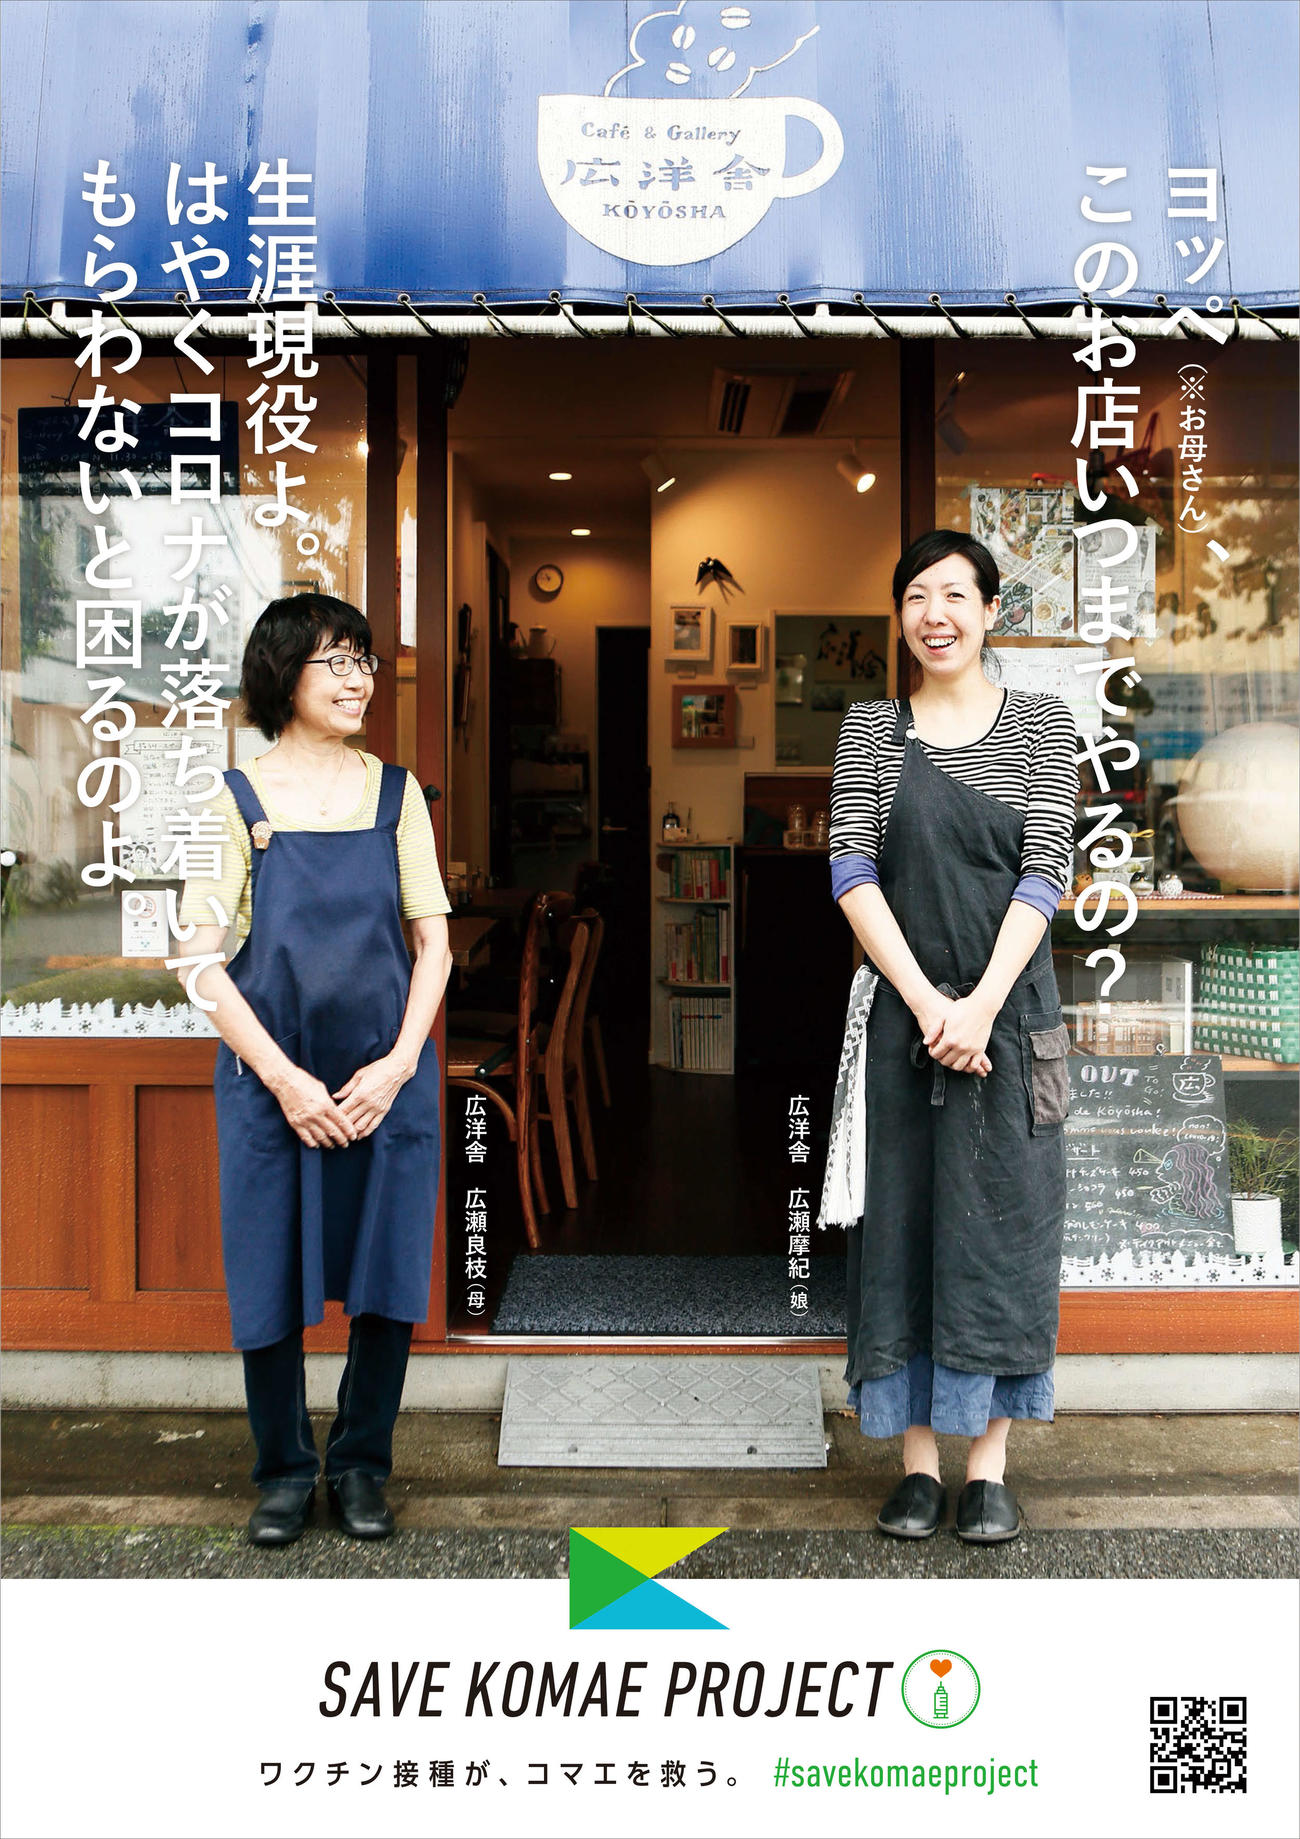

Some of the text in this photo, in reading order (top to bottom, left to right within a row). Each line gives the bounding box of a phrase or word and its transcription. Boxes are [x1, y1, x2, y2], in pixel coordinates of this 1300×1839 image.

[580, 121, 742, 147] Café & Gallery
[559, 153, 772, 192] 広洋舎
[602, 200, 727, 220] KŌYŌSHA
[1080, 1064, 1140, 1087] OUT
[1128, 1167, 1150, 1176] 450
[1115, 1190, 1135, 1199] 450
